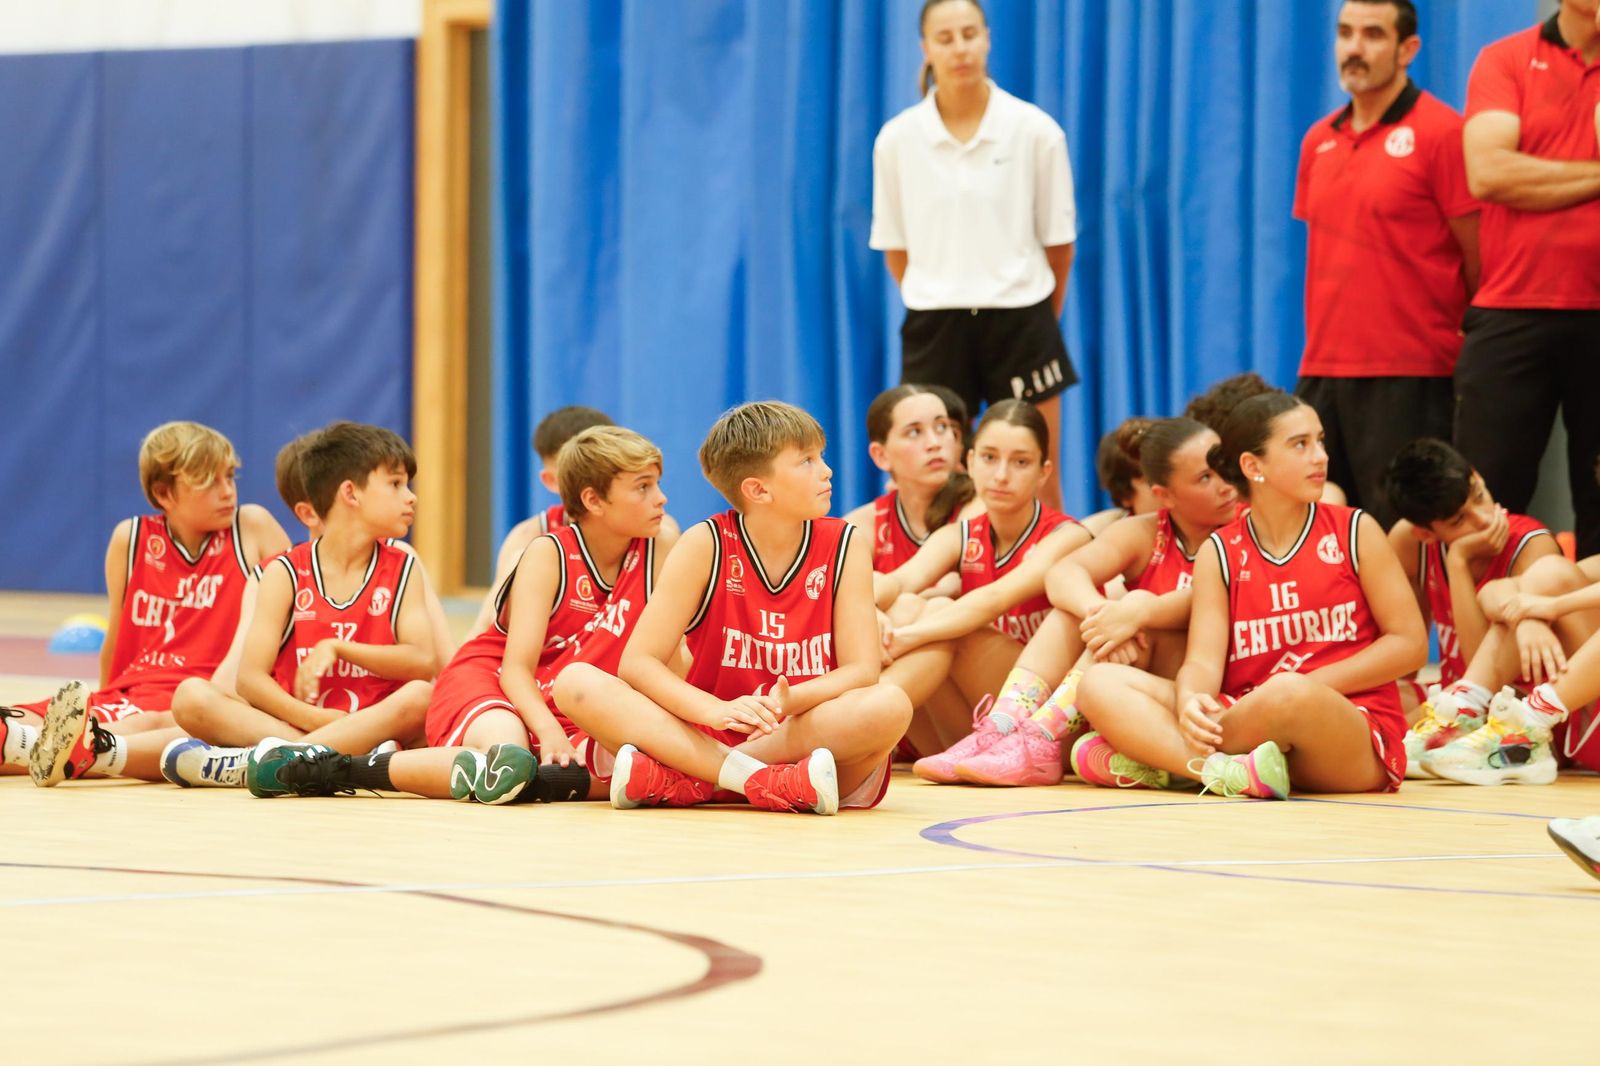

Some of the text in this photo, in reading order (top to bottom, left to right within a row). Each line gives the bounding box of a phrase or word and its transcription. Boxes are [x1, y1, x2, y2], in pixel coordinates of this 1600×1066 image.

[1269, 581, 1300, 612] 16
[758, 609, 786, 639] 15
[1229, 601, 1358, 662] ENTURIAS
[721, 626, 832, 677] ENTURIAS
